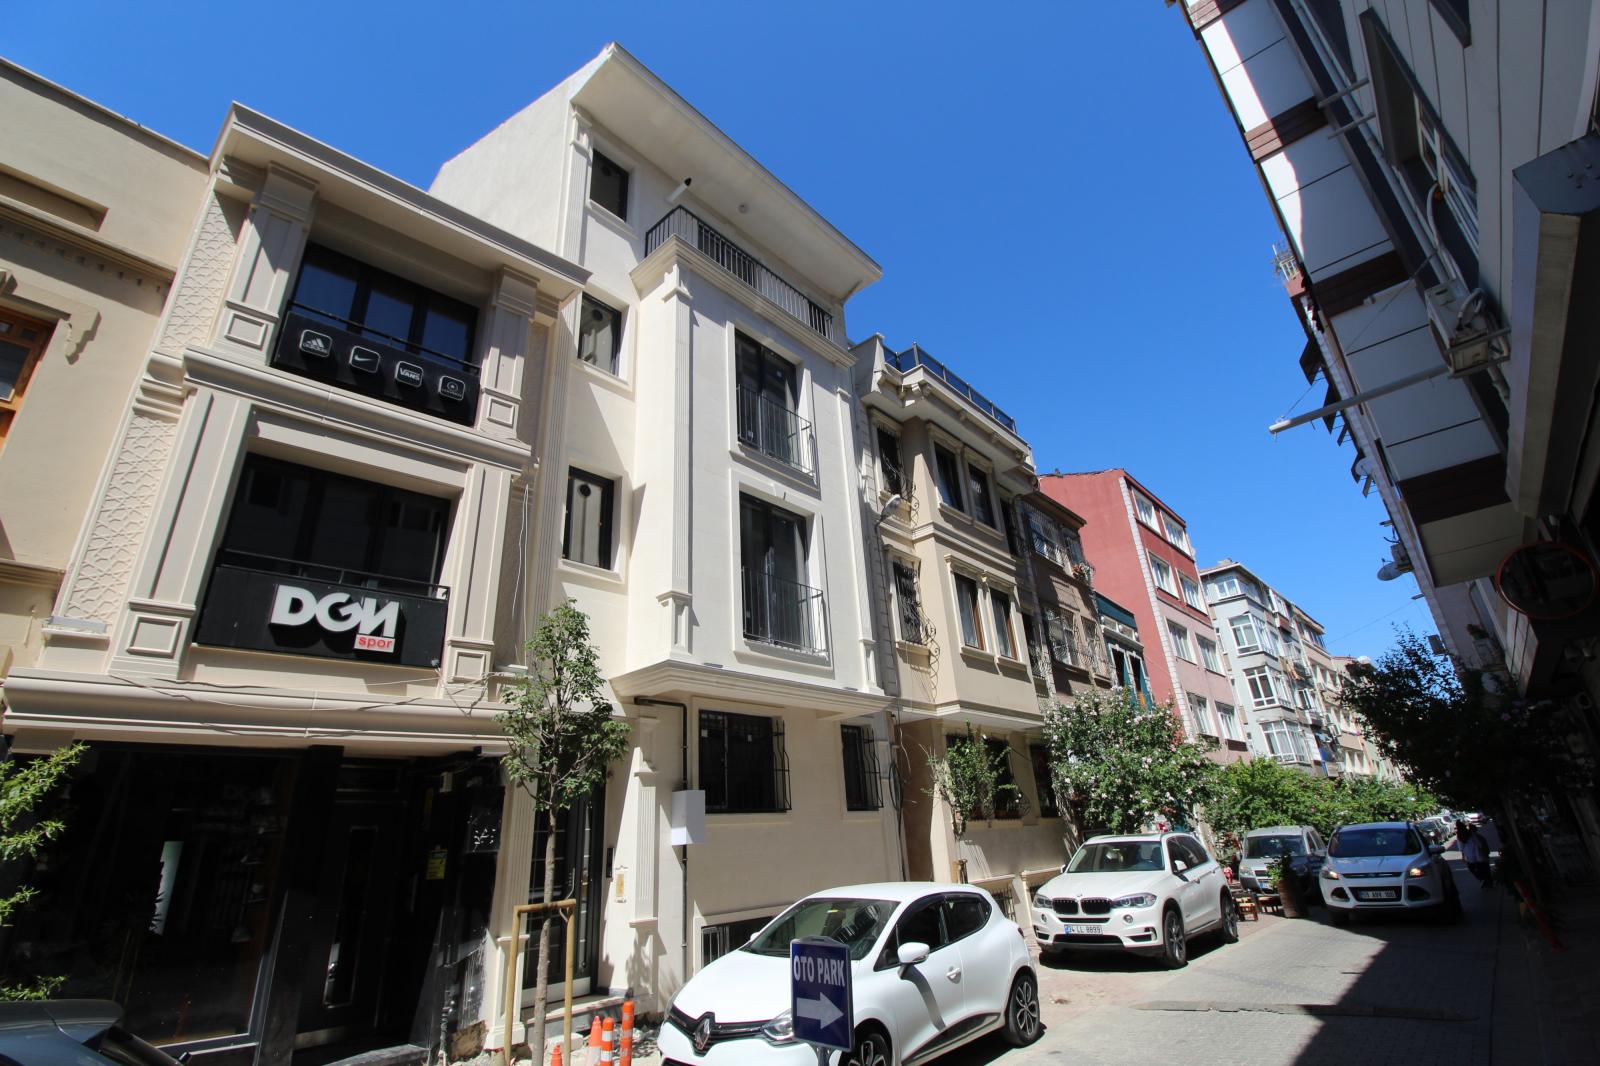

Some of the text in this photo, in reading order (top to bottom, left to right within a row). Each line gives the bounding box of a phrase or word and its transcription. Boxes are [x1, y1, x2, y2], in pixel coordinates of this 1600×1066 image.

[400, 368, 420, 380] VANS
[358, 636, 393, 648] spor
[793, 955, 846, 987] OTO PARK
